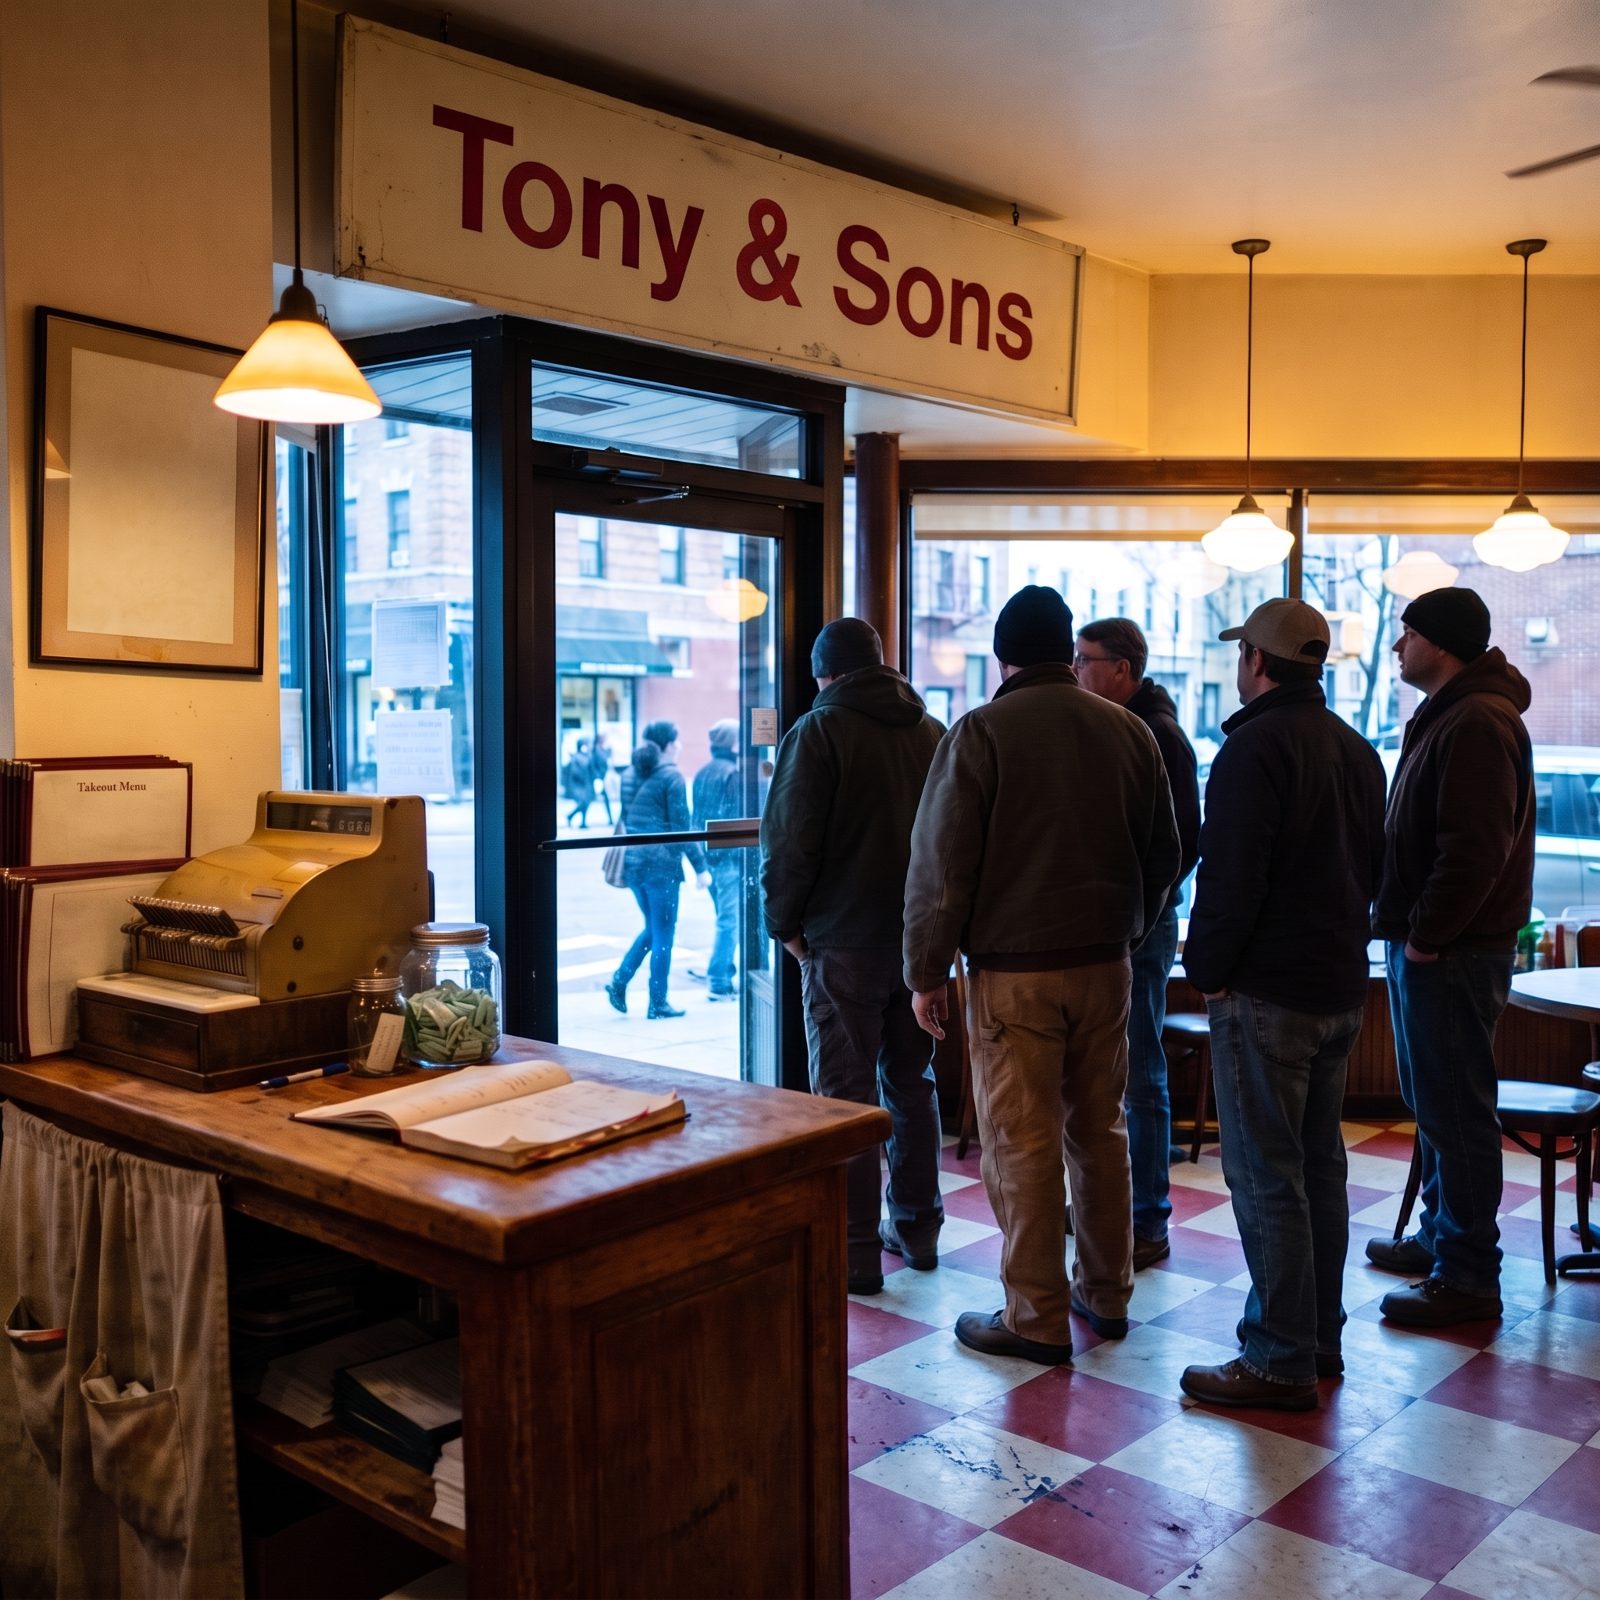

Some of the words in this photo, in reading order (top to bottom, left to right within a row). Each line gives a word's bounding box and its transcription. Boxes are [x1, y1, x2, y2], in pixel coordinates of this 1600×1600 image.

[432, 103, 705, 302] Tony
[736, 198, 802, 308] &
[833, 224, 1033, 361] Sons
[77, 782, 117, 792] Takeout
[119, 781, 146, 791] Menu
